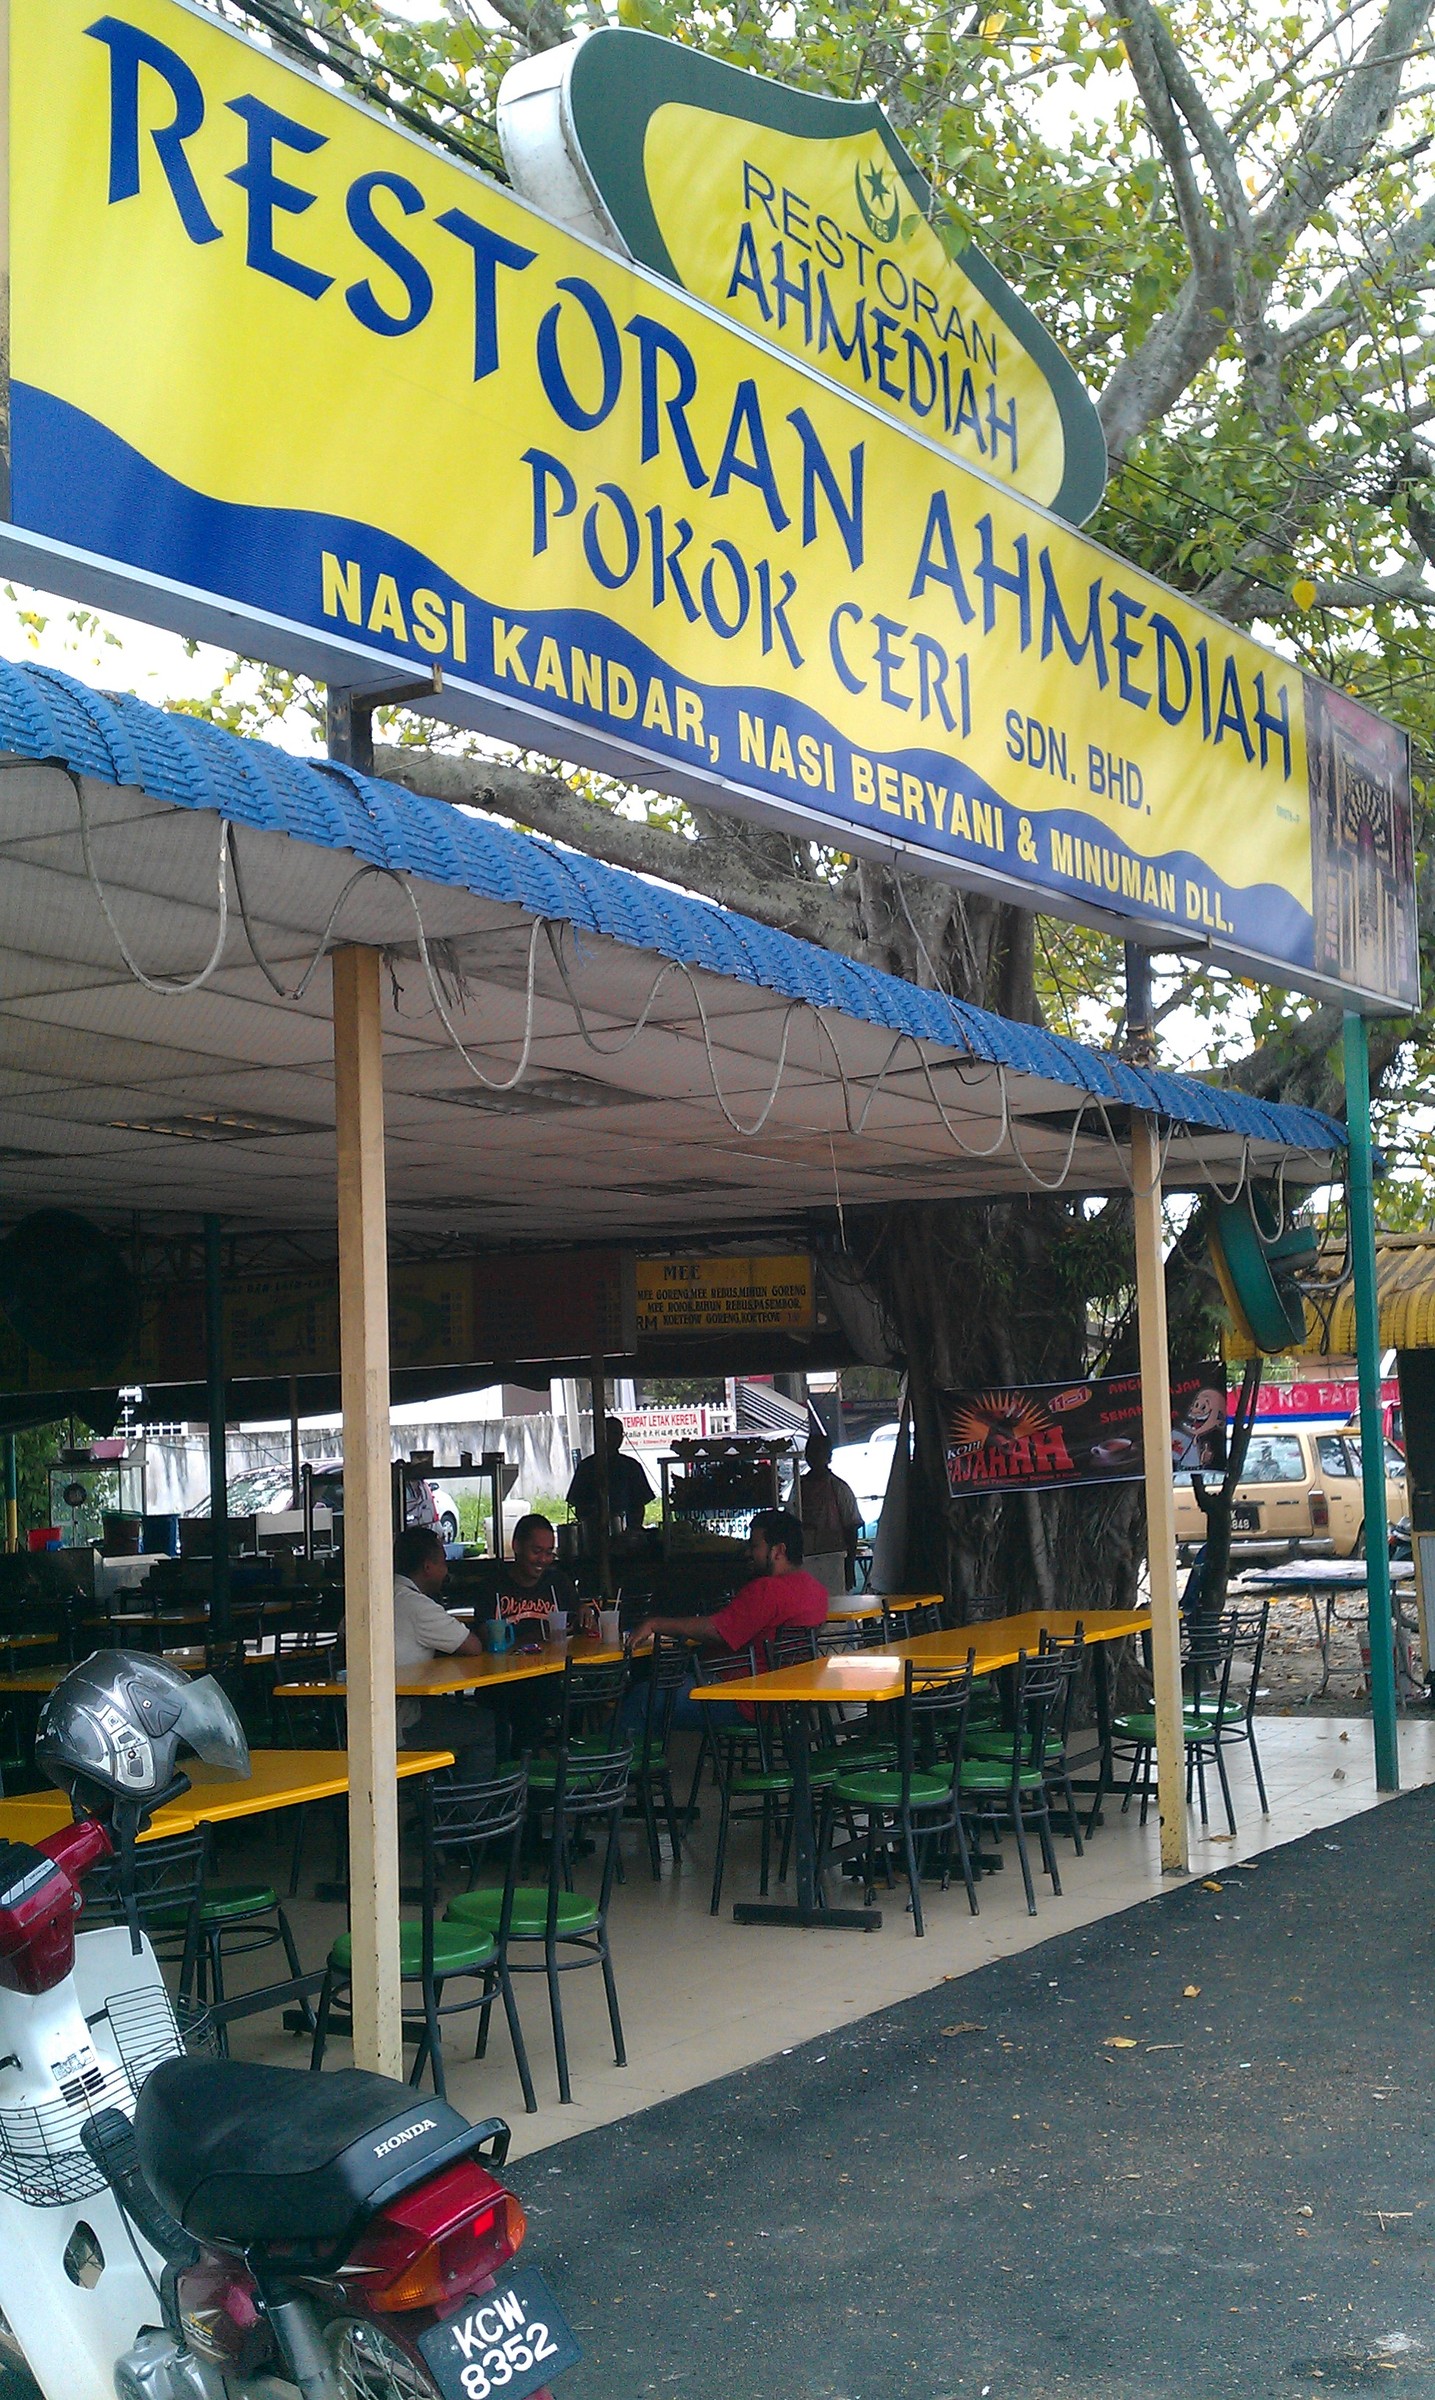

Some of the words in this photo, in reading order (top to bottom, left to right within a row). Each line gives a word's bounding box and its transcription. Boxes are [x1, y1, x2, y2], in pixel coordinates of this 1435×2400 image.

[743, 160, 998, 377] RESTORAN
[82, 15, 866, 572] RESTORAN
[910, 488, 1294, 783] AHMEDIAH
[727, 220, 1018, 474] AHMEDIAH
[519, 446, 804, 668] POKOK
[828, 602, 971, 740] CERI
[321, 550, 467, 664] NASI
[492, 616, 721, 764] KANDAR,
[738, 710, 836, 794] NASI
[851, 753, 1005, 853] BERYANI
[1017, 816, 1039, 865] &
[1050, 828, 1176, 914] MINUMAN
[1185, 879, 1235, 934] DLL.
[1005, 709, 1076, 785] SDN.
[1088, 744, 1151, 816] BHD.
[664, 1264, 700, 1281] MEE
[623, 1415, 647, 1428] TEMPAT
[649, 1414, 670, 1427] LETAK
[671, 1413, 698, 1426] KERETA
[373, 2118, 437, 2159] HONDA
[451, 2289, 527, 2360] KCW
[460, 2322, 558, 2400] 8352
